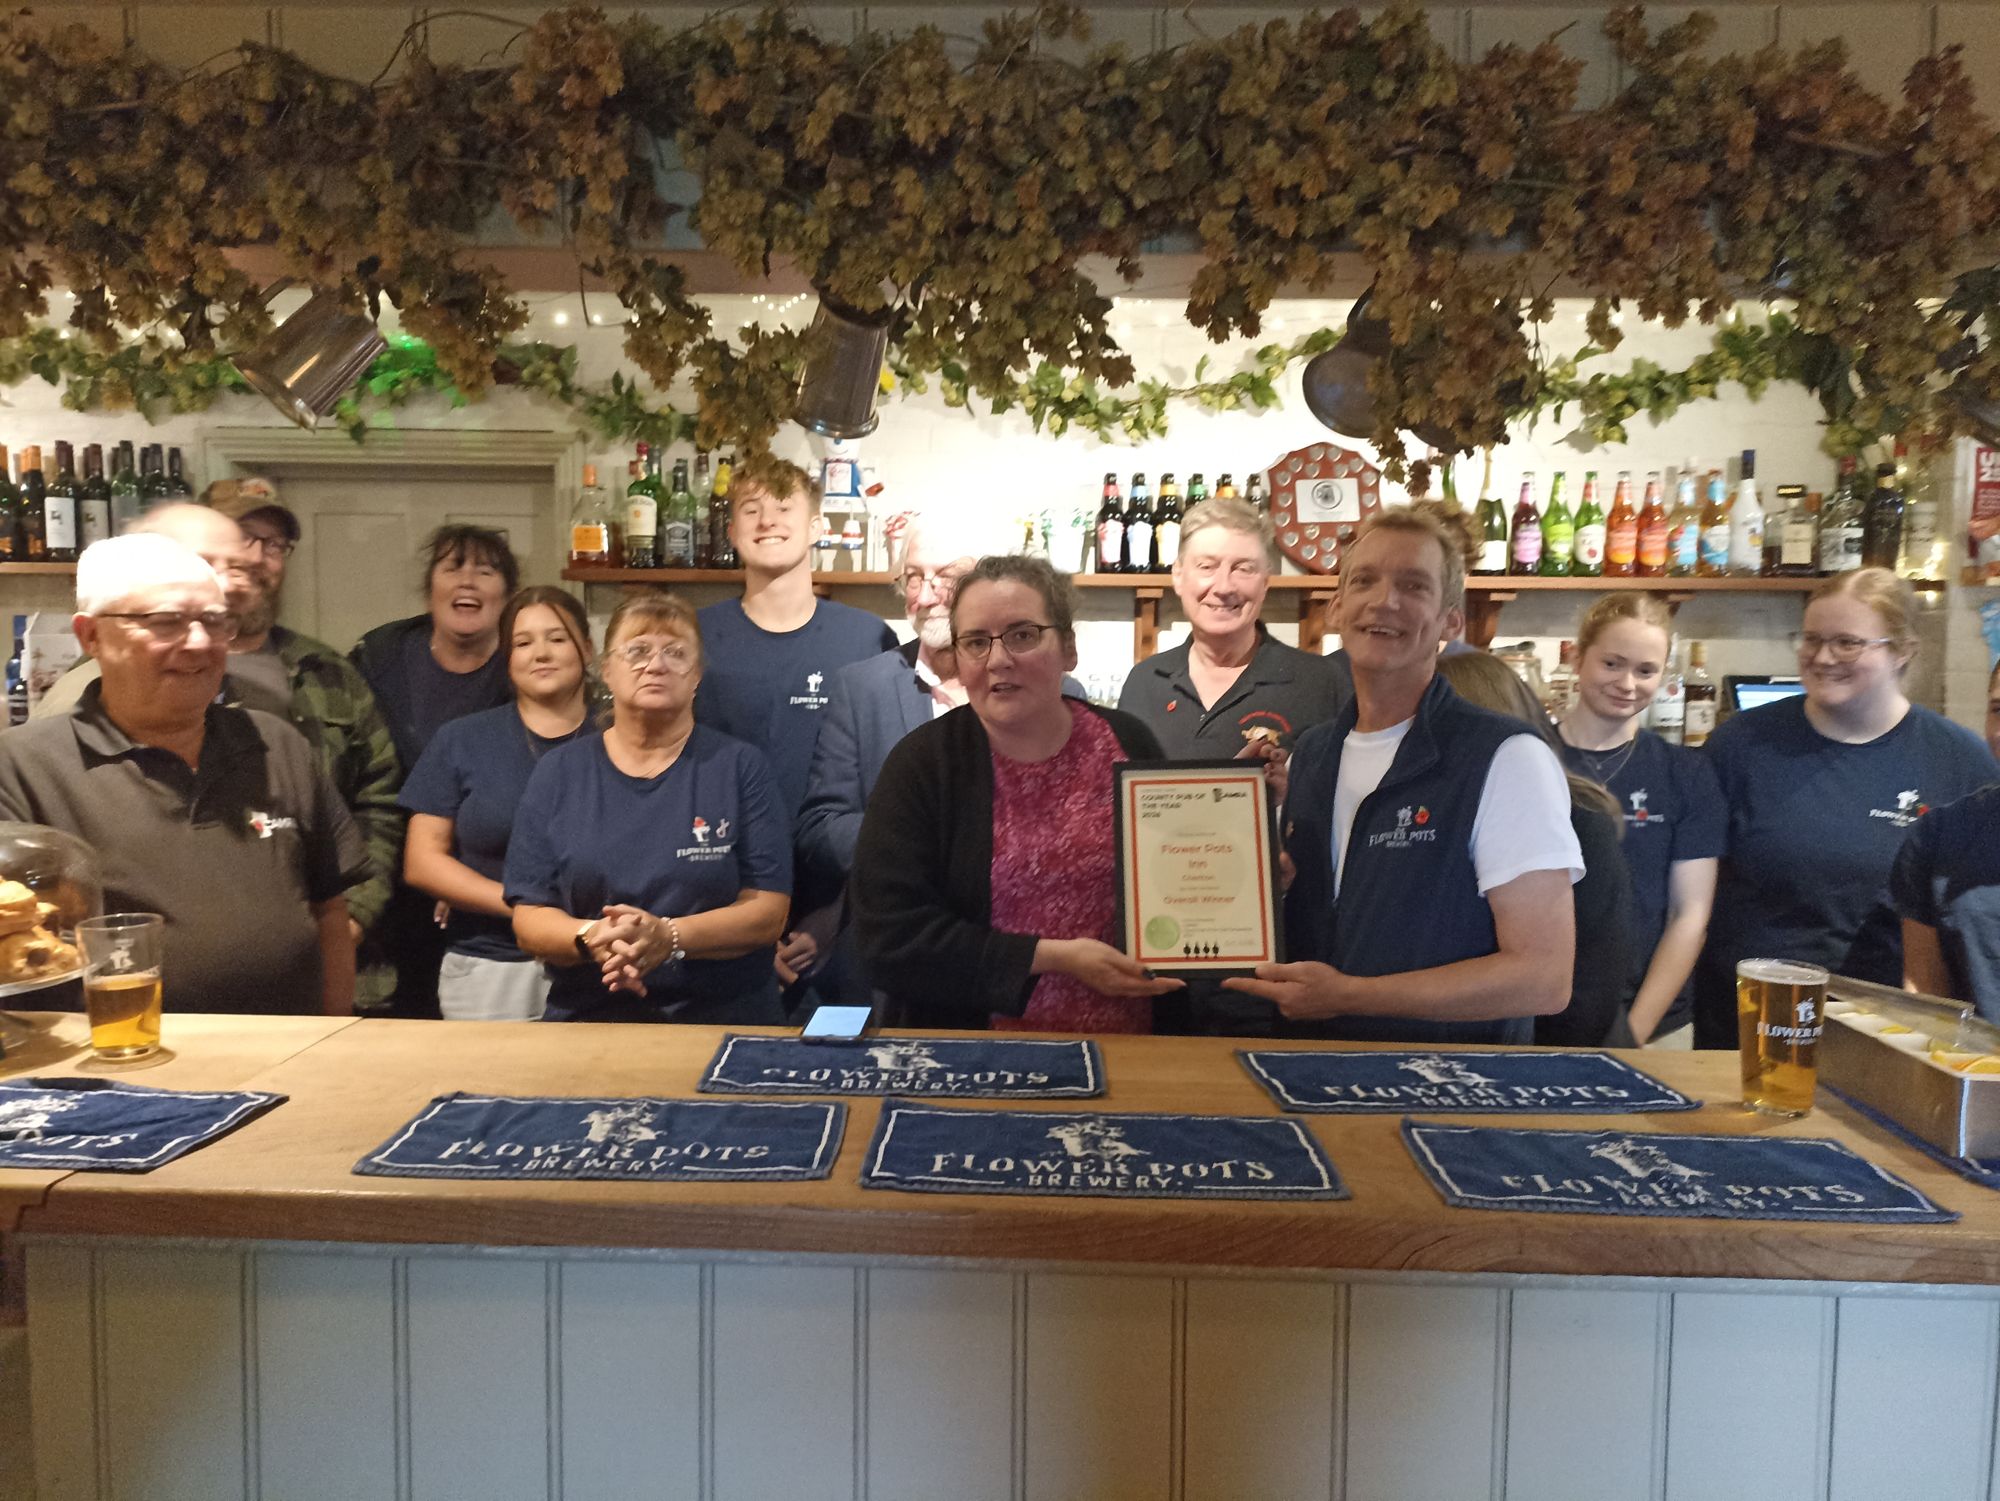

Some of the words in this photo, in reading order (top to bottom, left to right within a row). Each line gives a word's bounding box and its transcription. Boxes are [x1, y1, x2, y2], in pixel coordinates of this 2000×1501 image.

[1161, 844, 1202, 854] Flower
[1204, 843, 1233, 854] Pots
[1188, 860, 1208, 869] Inn
[763, 1068, 928, 1081] FLOWER
[945, 1070, 1049, 1085] POTS
[1323, 1083, 1505, 1099] FLOWER
[1510, 1085, 1629, 1099] POTS
[437, 1137, 635, 1160] FLOWER
[650, 1141, 770, 1161] POTS
[521, 1156, 667, 1171] BREWERY
[930, 1151, 1131, 1176] FLOWER
[1150, 1159, 1275, 1181] POTS
[1028, 1173, 1173, 1189] BREWERY
[1500, 1174, 1711, 1198] FLOWER
[1724, 1184, 1866, 1203] POTS
